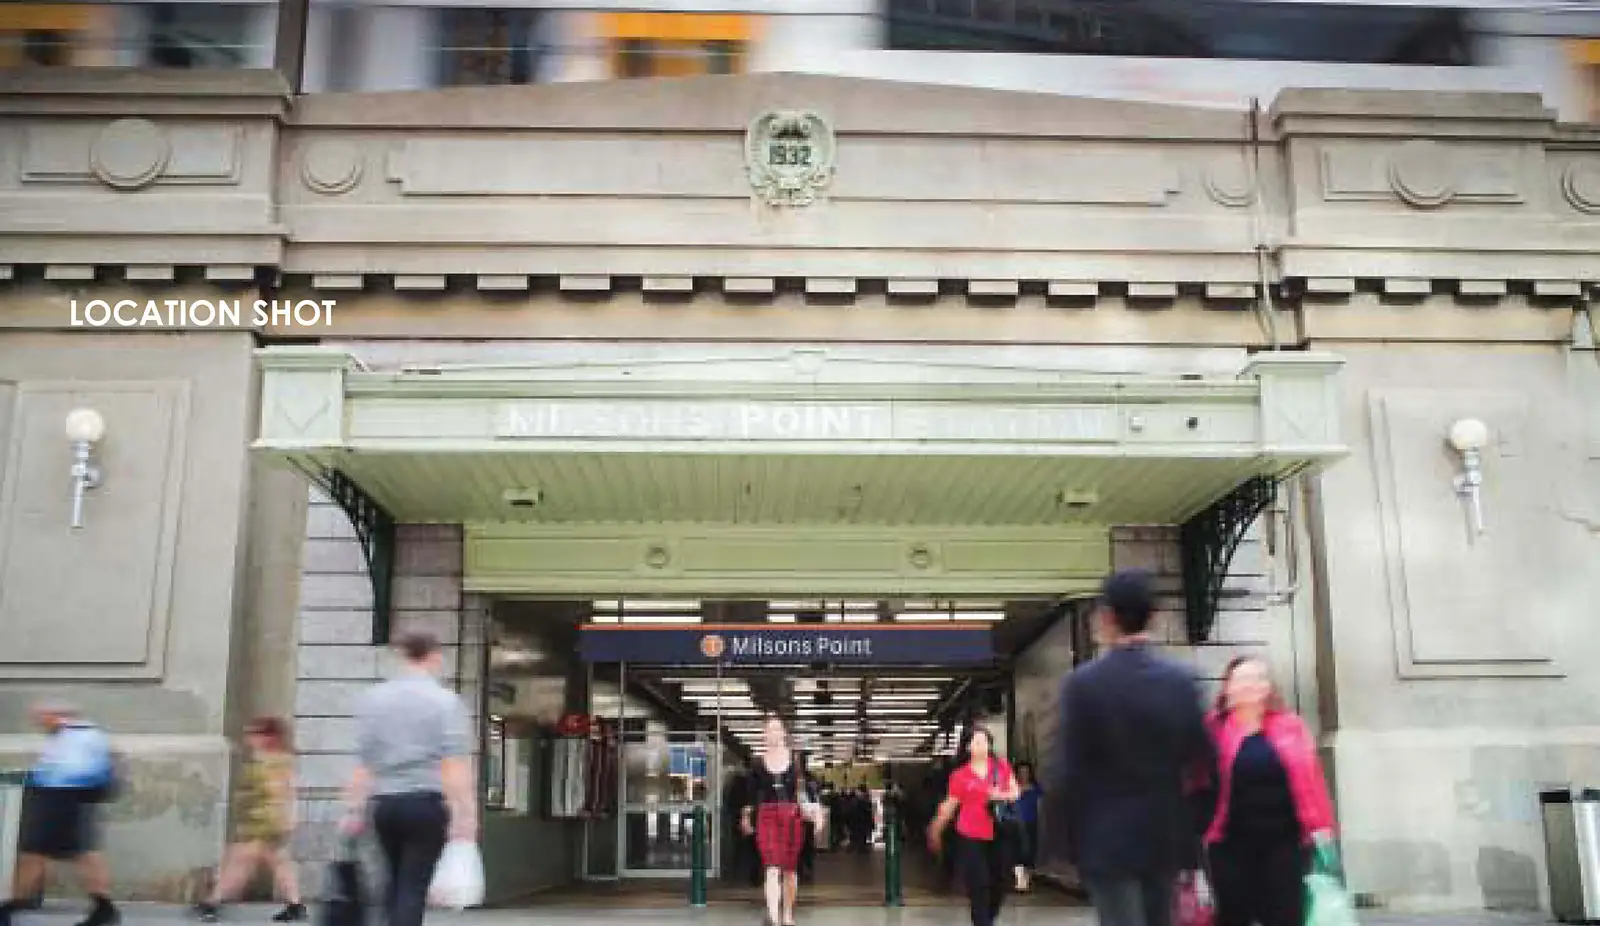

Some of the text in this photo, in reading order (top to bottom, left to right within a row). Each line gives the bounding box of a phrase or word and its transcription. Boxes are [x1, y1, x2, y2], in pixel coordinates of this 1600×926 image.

[769, 144, 812, 167] 1932
[740, 405, 882, 437] POINT
[732, 635, 812, 656] Milsons
[817, 635, 873, 656] Point
